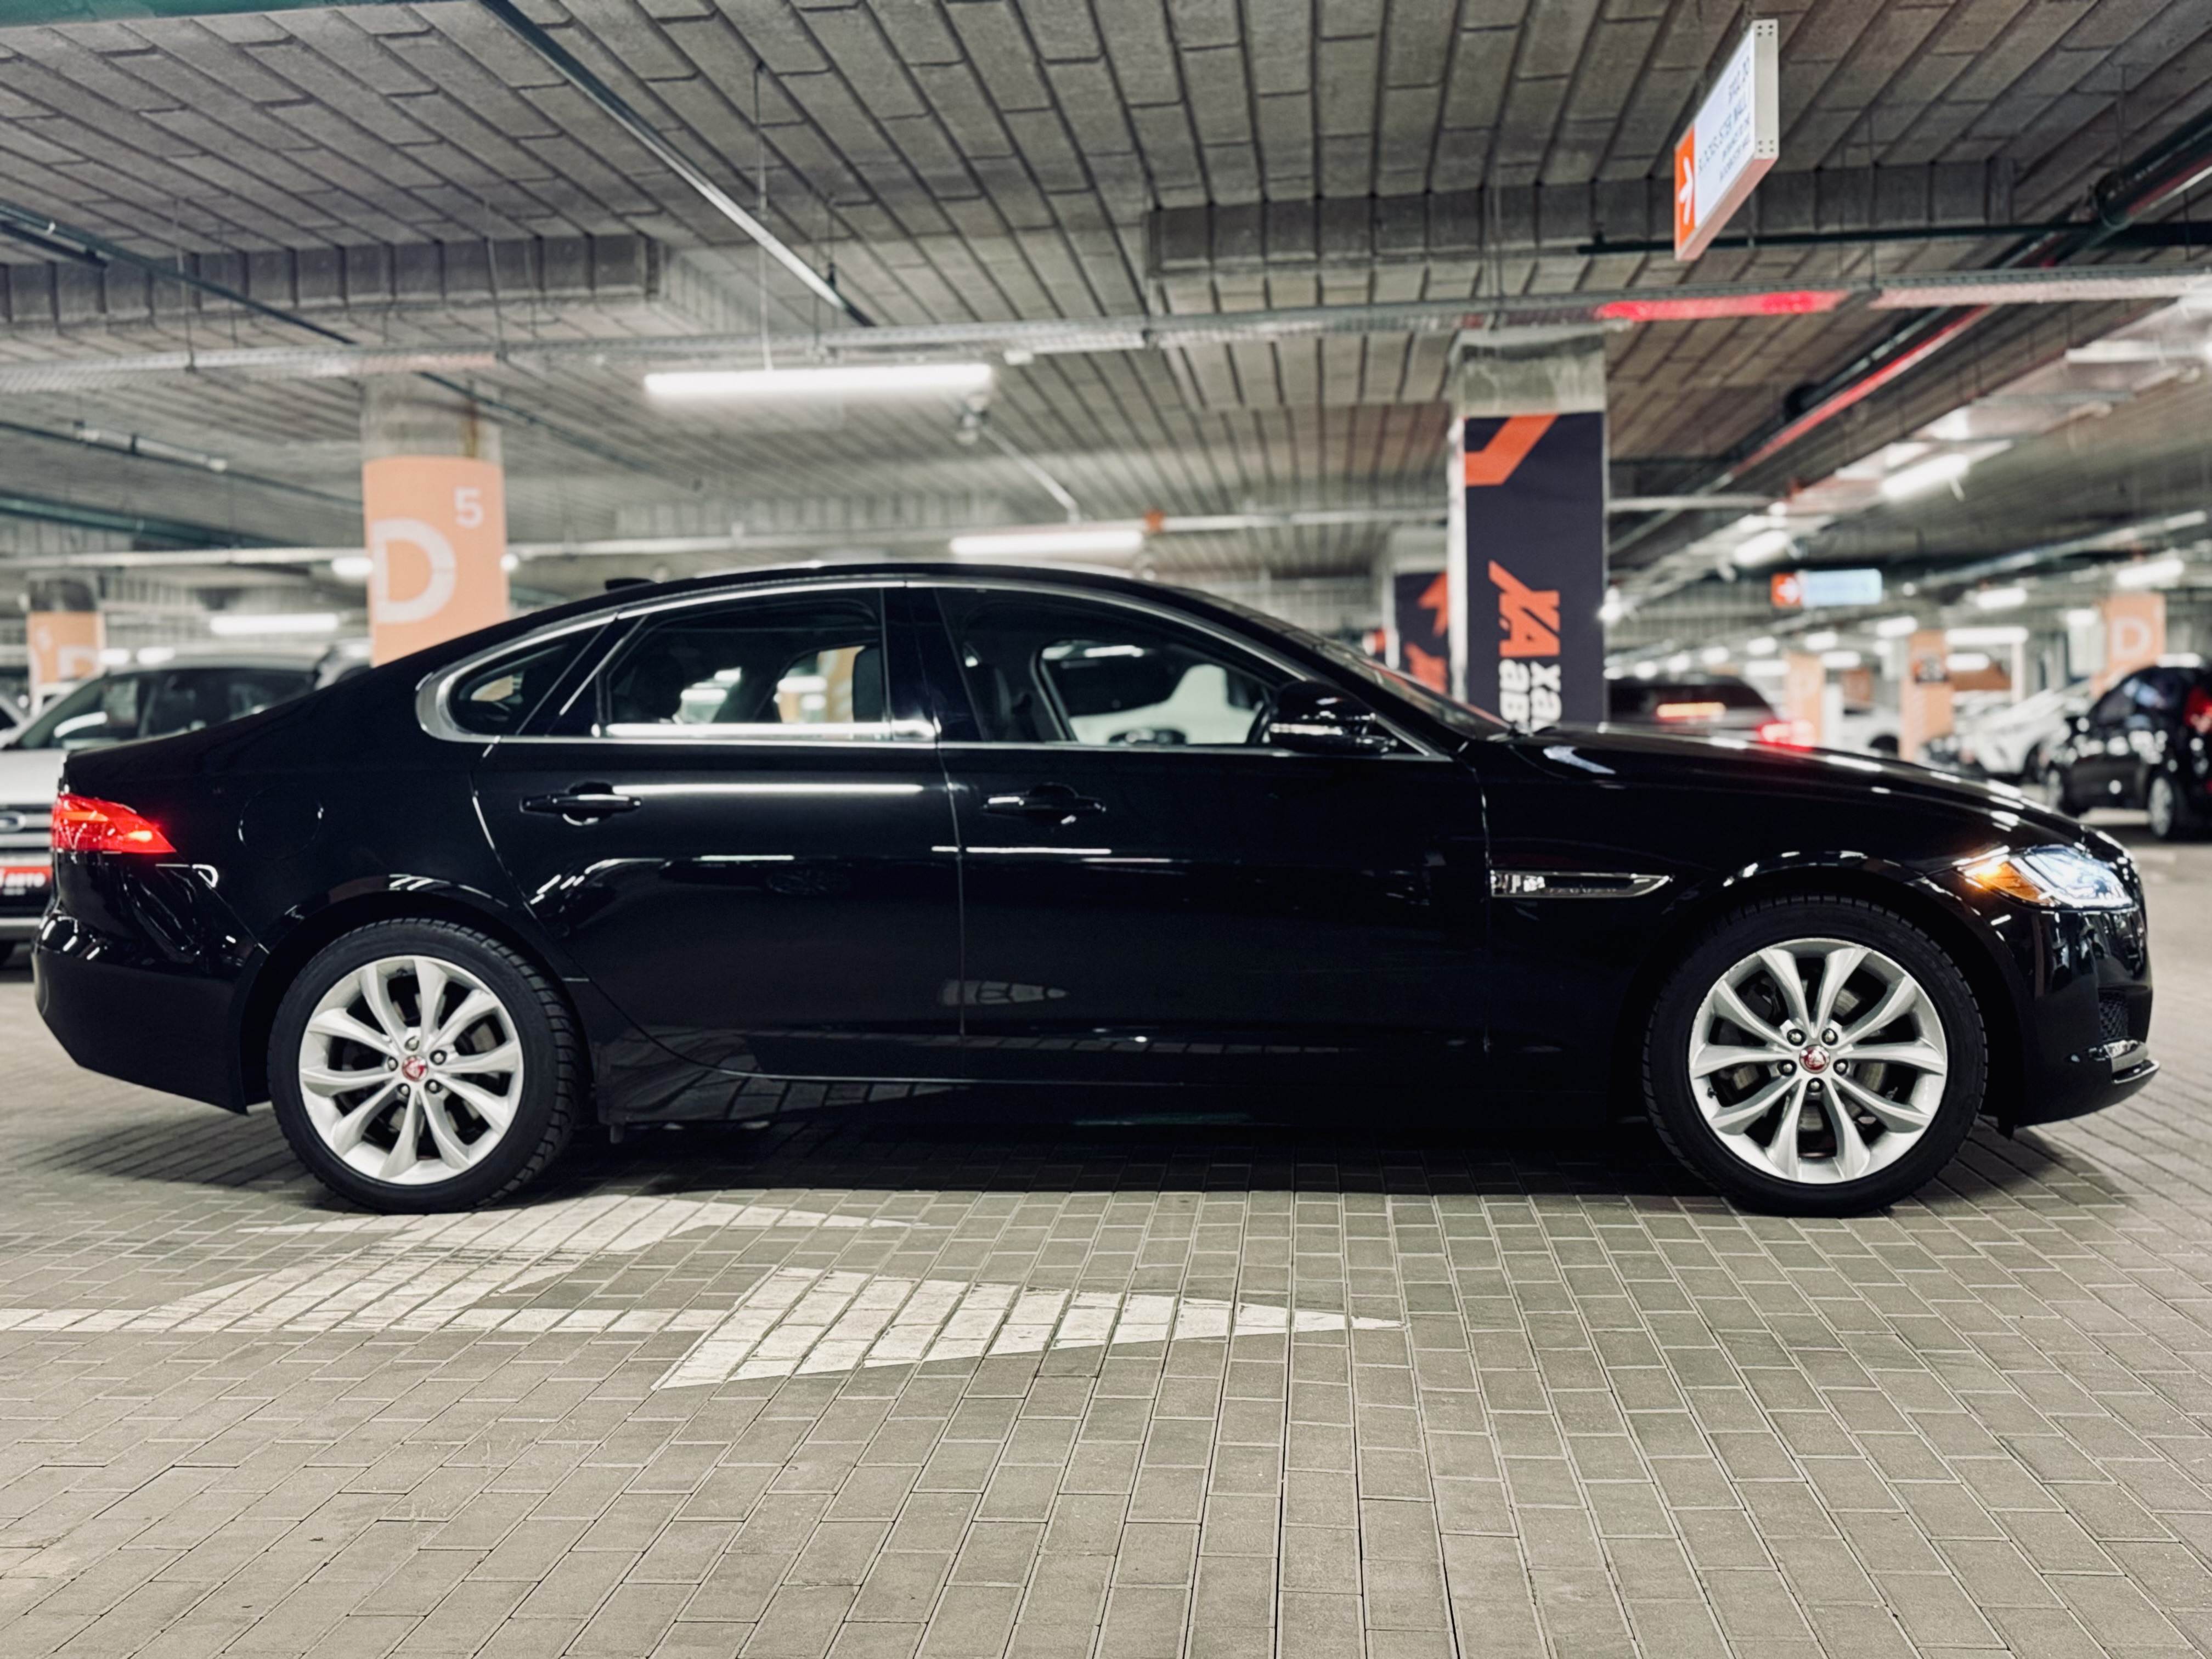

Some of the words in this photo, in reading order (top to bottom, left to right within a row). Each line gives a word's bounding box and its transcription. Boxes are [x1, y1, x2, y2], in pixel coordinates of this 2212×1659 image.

[454, 487, 483, 528] 5
[373, 517, 456, 625] D
[2113, 618, 2153, 660] D
